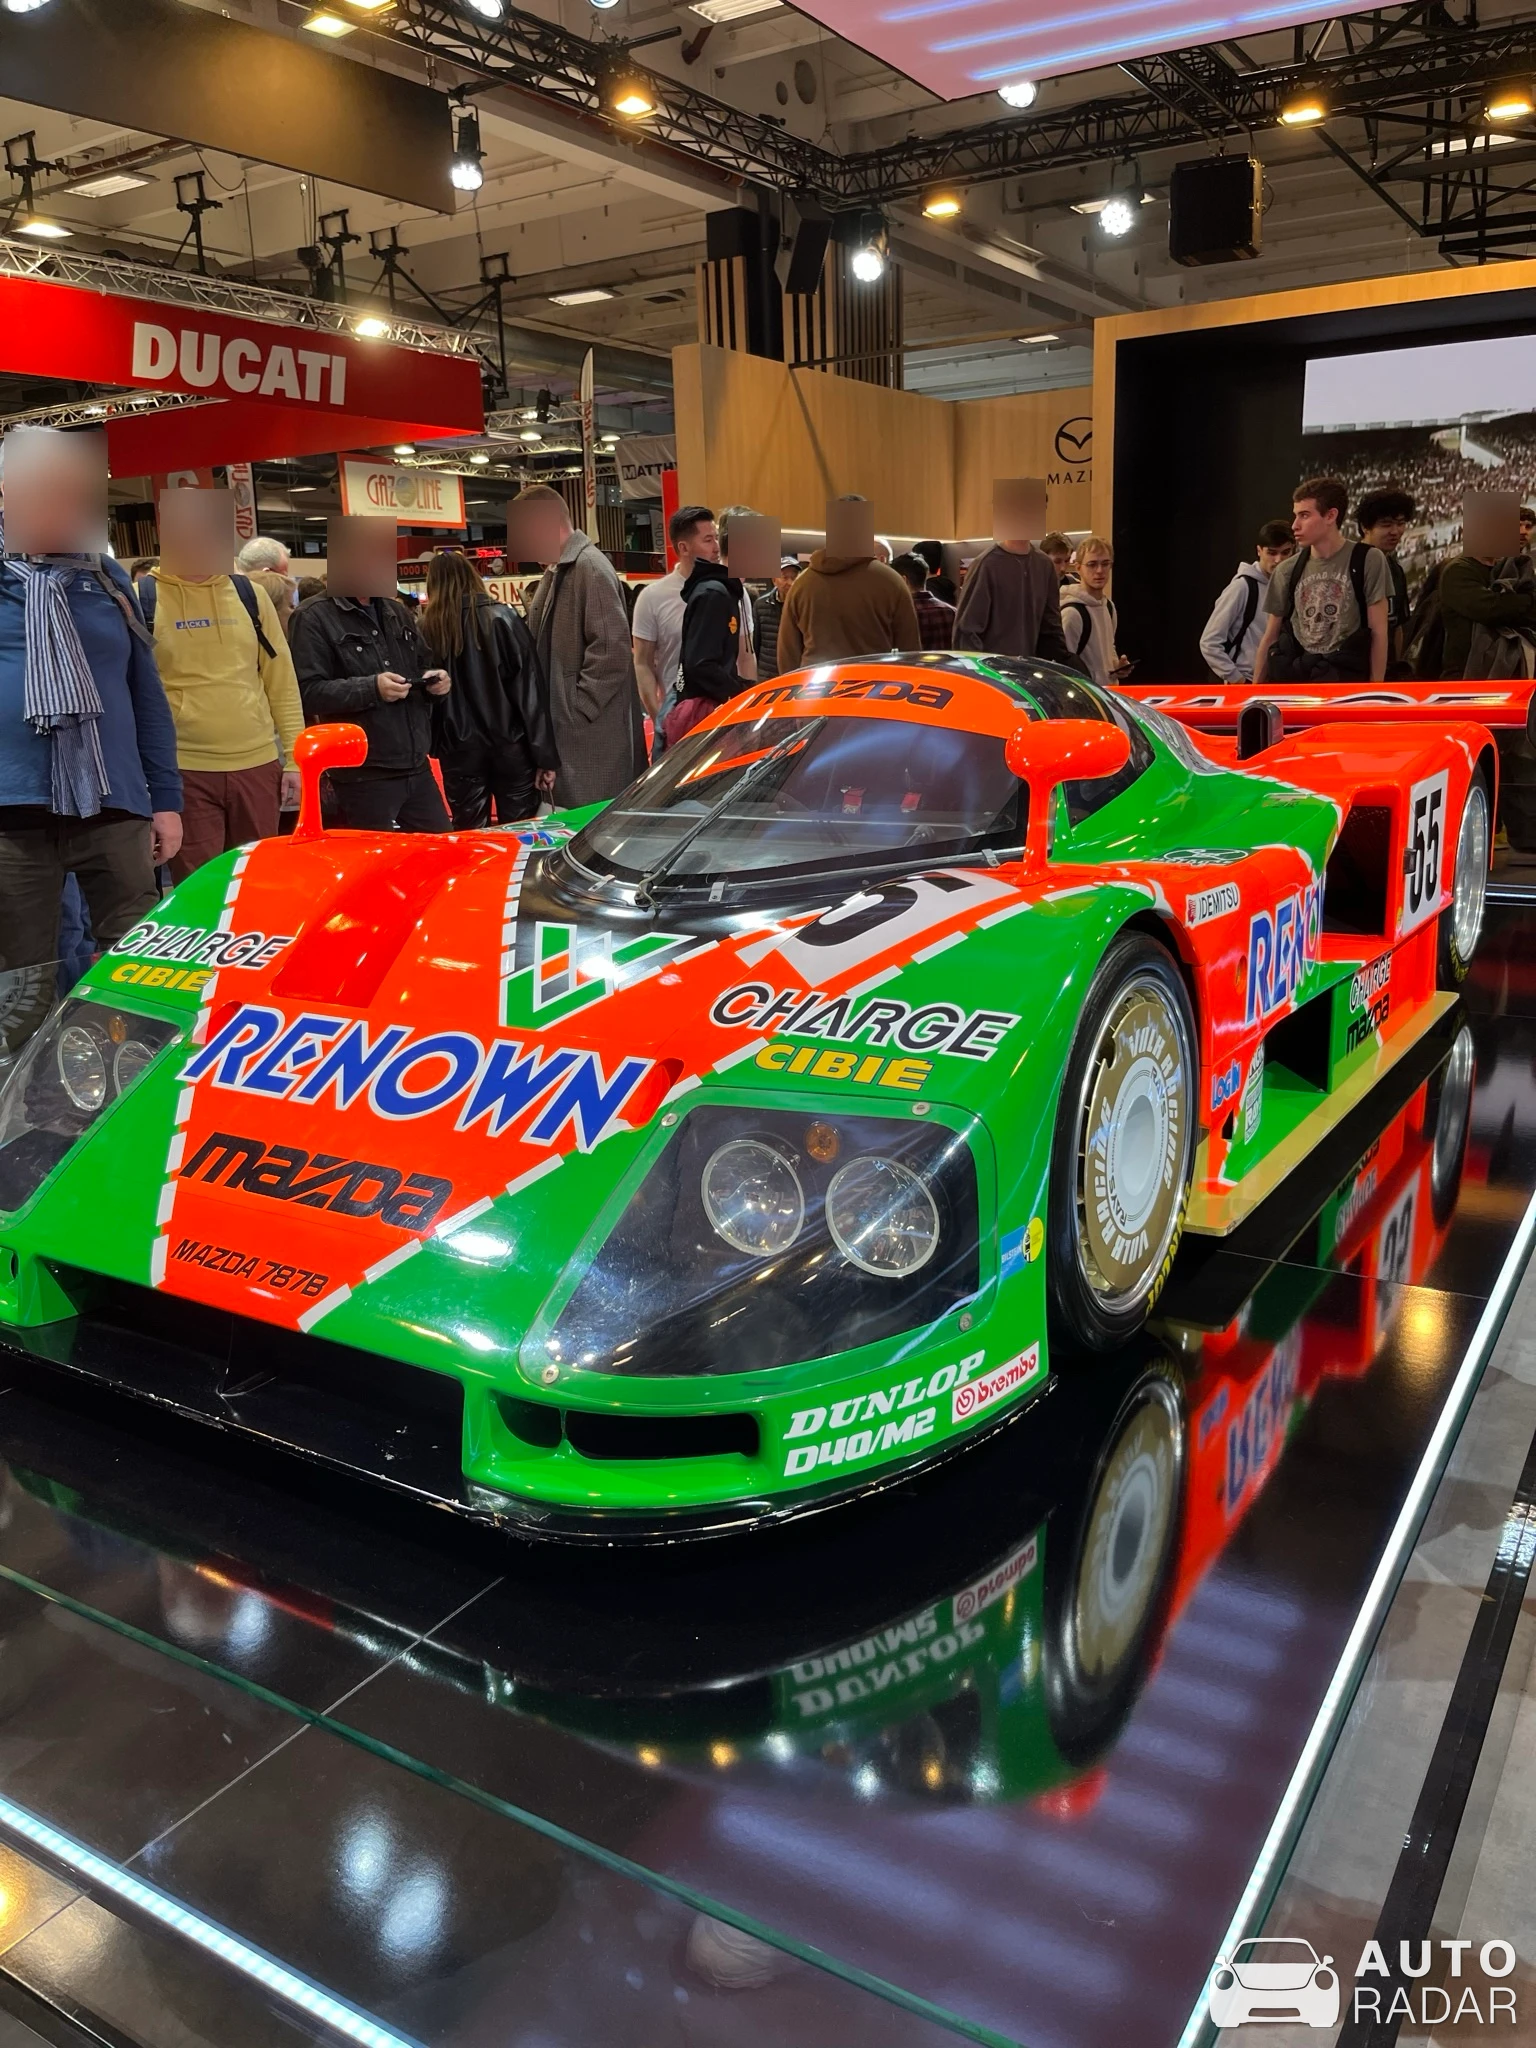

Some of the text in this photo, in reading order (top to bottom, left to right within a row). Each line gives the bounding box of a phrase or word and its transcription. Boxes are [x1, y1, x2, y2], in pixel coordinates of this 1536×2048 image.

[132, 321, 347, 406] DUCATI
[1047, 470, 1092, 486] MAZ
[488, 581, 524, 602] SIM
[1410, 788, 1443, 914] 55
[1199, 887, 1239, 920] IDEMITSU
[108, 921, 297, 970] CHARGE
[1350, 951, 1392, 1013] CHARGE
[709, 982, 1022, 1062] CHARGE
[176, 1003, 656, 1154] RENOWN
[172, 1239, 329, 1298] MAZDA 787B
[783, 1350, 985, 1440] DUNLOP
[977, 1352, 1037, 1405] brembo
[784, 1406, 936, 1477] D40/M2
